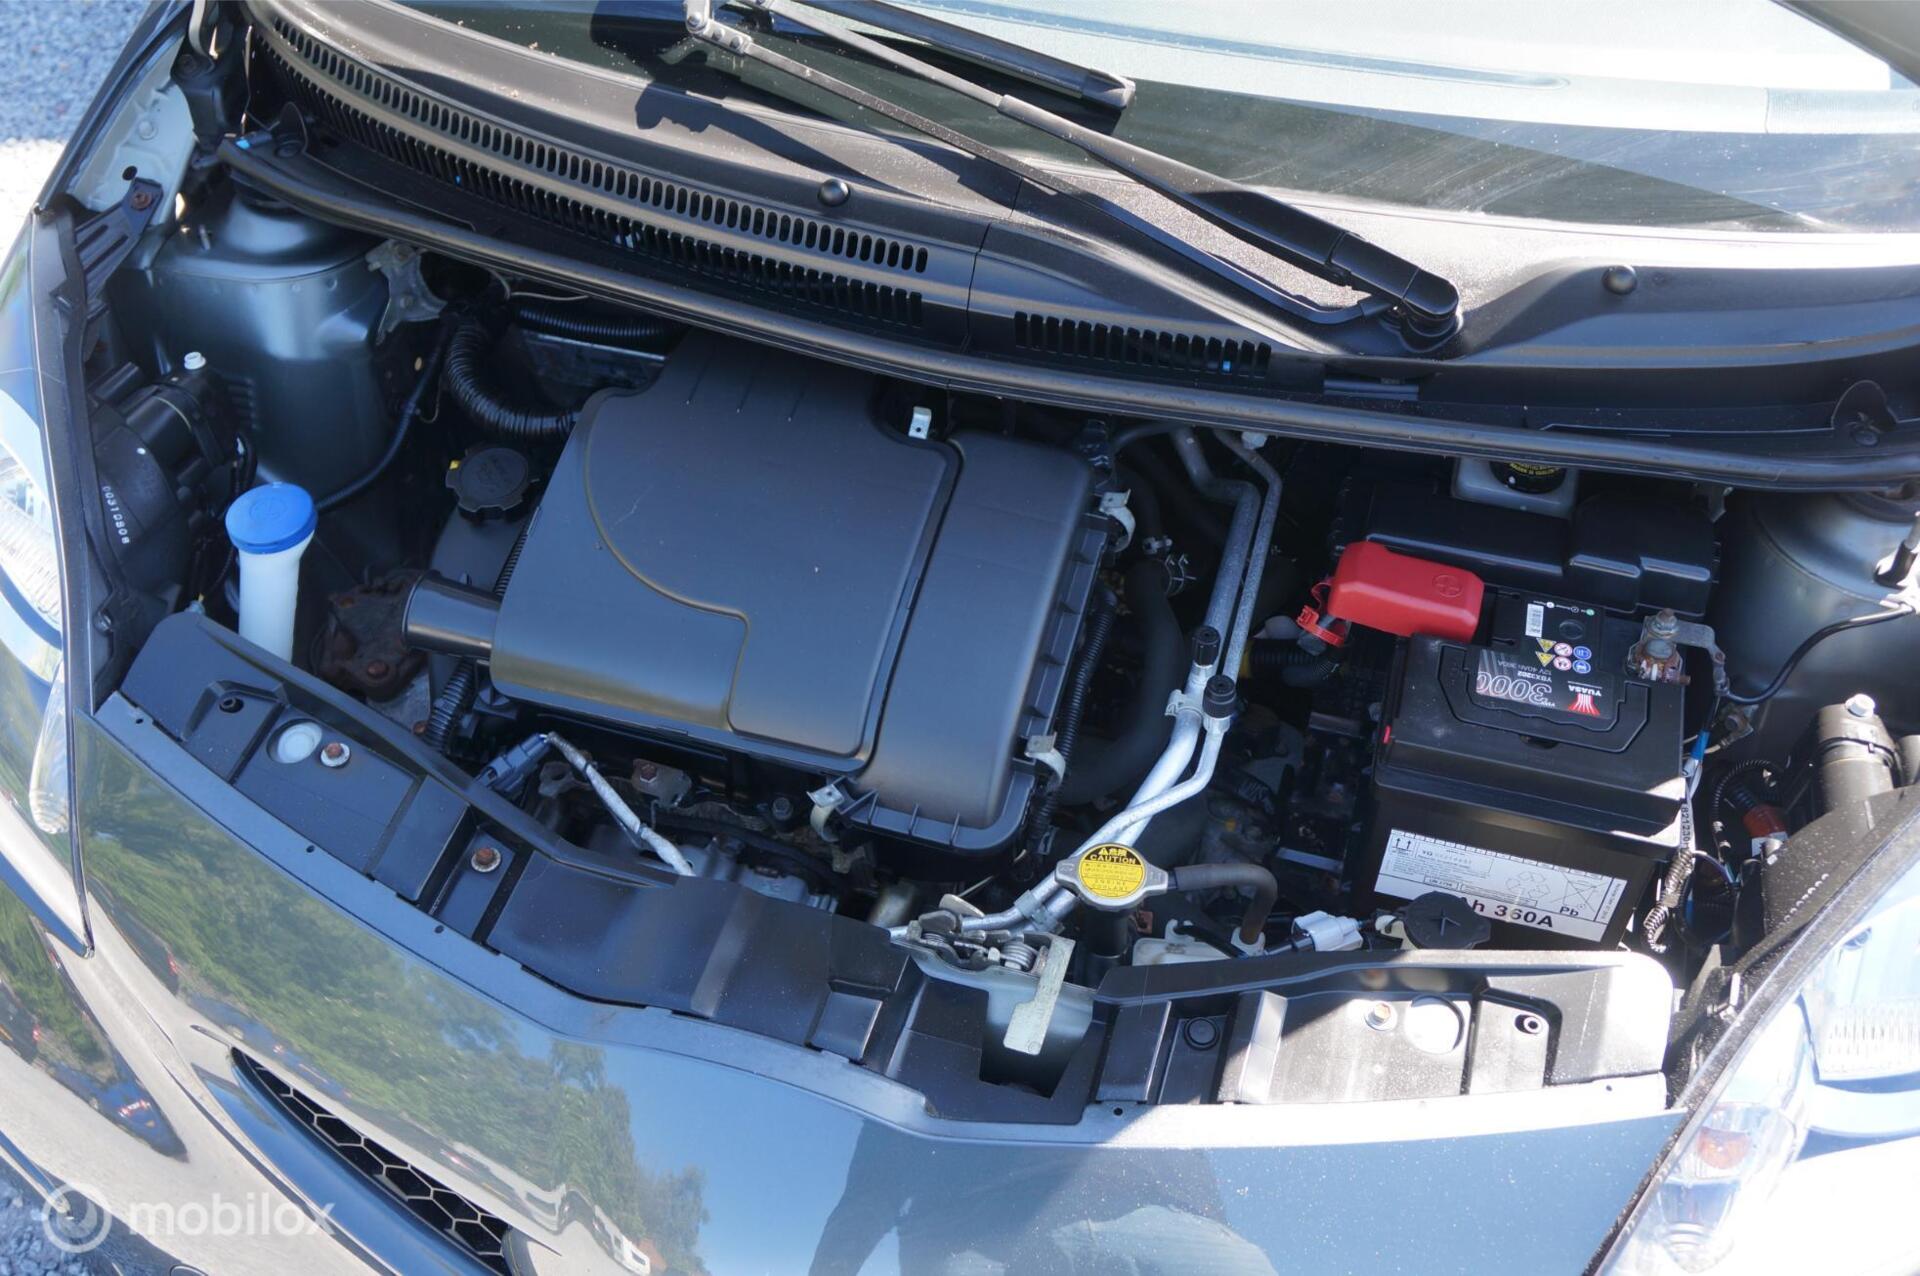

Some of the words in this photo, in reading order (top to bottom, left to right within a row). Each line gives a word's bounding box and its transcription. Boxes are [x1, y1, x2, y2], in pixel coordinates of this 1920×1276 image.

[1476, 671, 1552, 705] 3000
[1568, 684, 1602, 697] YUASA
[1090, 854, 1136, 865] CAUTION
[1494, 905, 1553, 928] 360A
[1559, 906, 1579, 917] Pb
